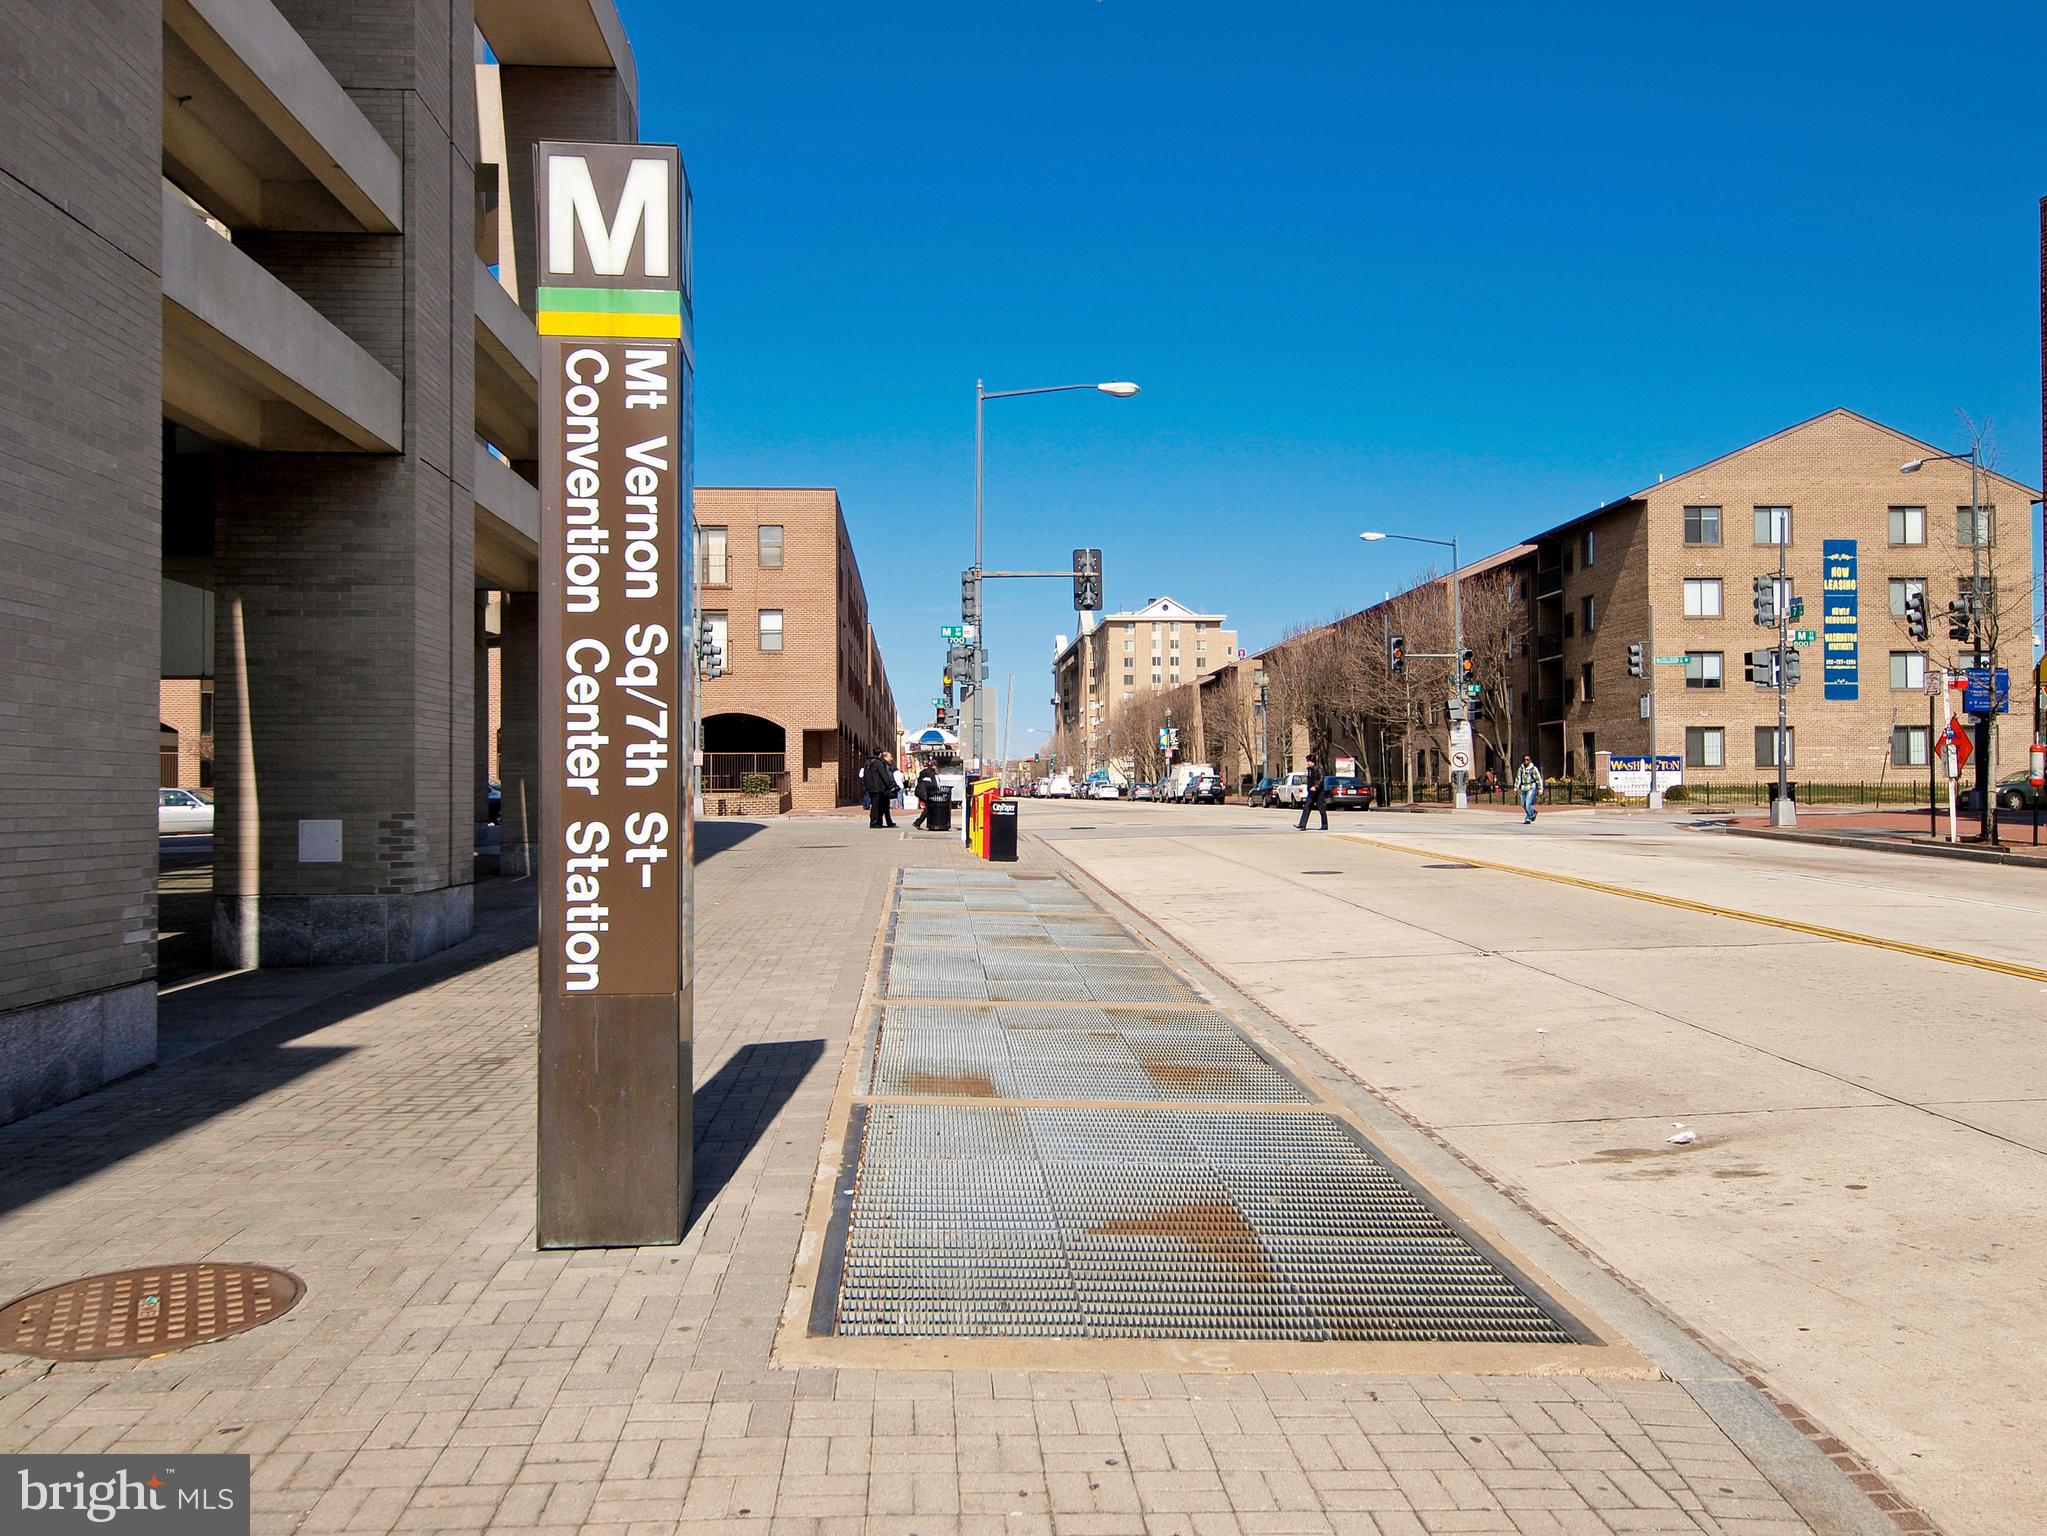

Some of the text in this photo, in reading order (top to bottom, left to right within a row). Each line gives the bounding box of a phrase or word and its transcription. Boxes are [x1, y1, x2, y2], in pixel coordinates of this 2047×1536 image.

[549, 156, 669, 277] M
[1831, 567, 1849, 577] NOW
[1824, 580, 1856, 590] LEASING
[615, 349, 669, 888] Mt Vernon Sq/7th St-
[942, 627, 952, 636] M
[1797, 631, 1806, 640] M
[565, 348, 611, 991] Convention Center Station
